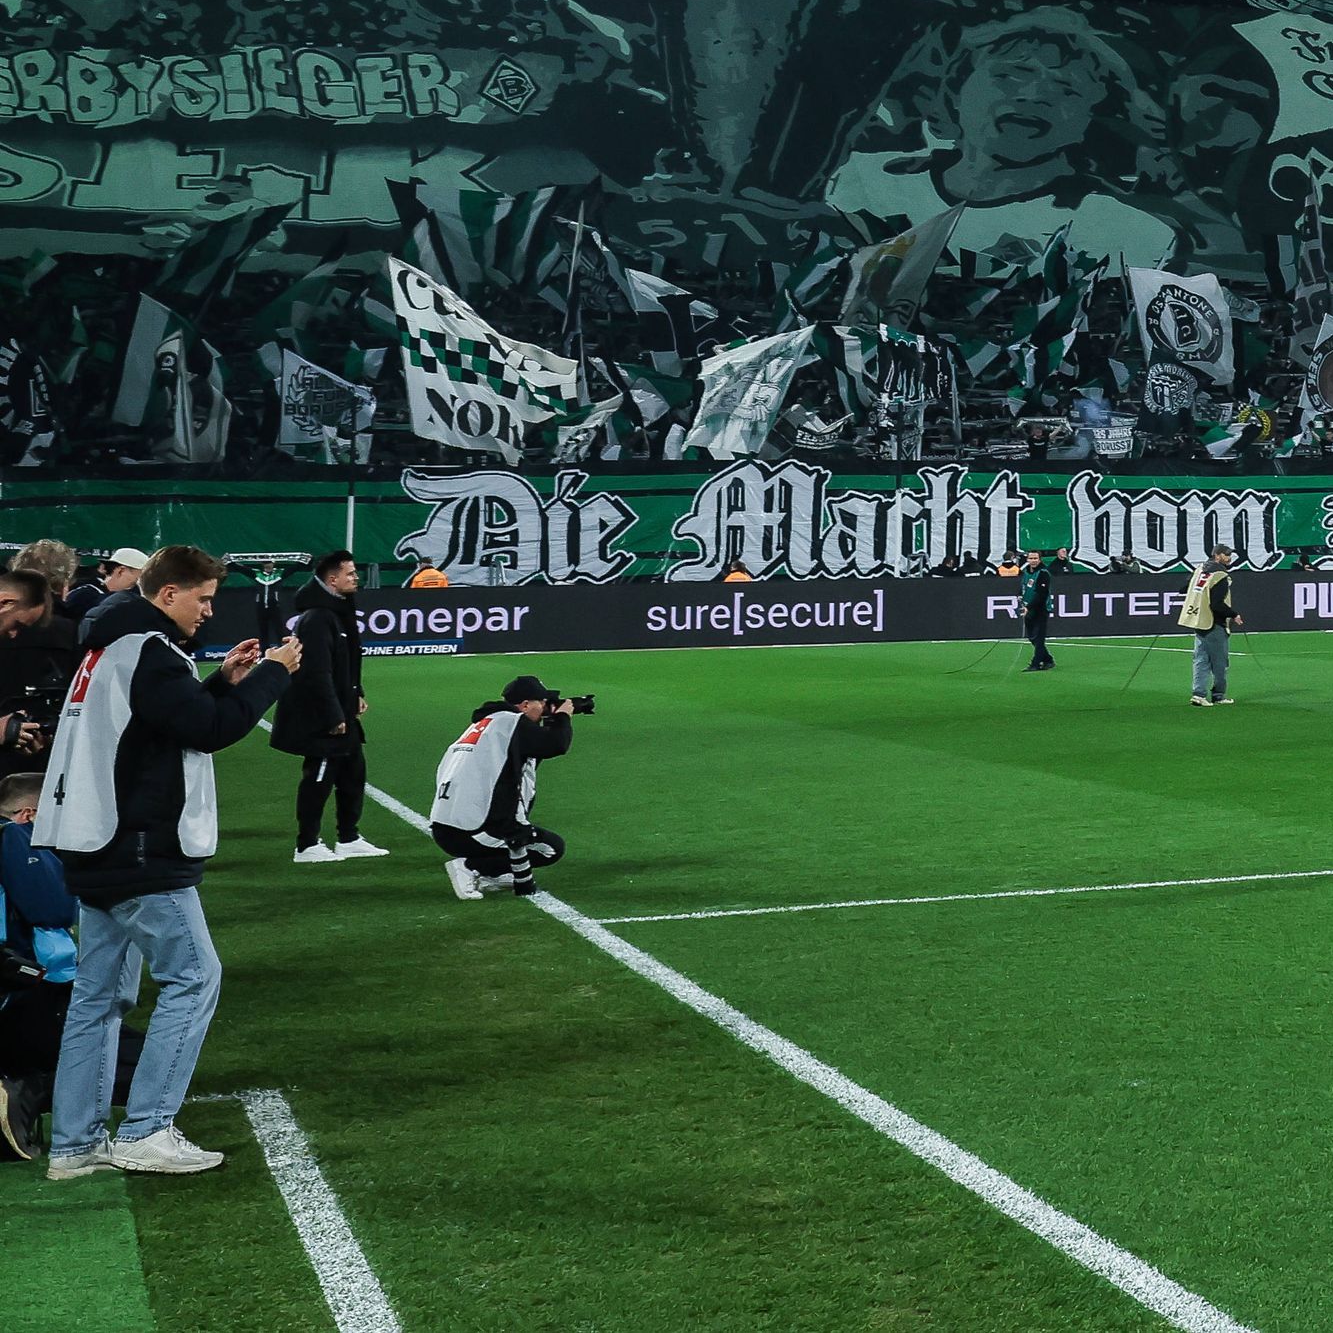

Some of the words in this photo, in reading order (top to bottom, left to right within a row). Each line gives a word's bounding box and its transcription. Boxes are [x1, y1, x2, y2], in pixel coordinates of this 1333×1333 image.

[396, 466, 640, 585] Die
[664, 458, 1036, 583] Macht
[1068, 469, 1282, 572] vom
[647, 590, 885, 636] sure[secure]
[1186, 605, 1199, 616] 24
[394, 644, 458, 655] BATTERIEN
